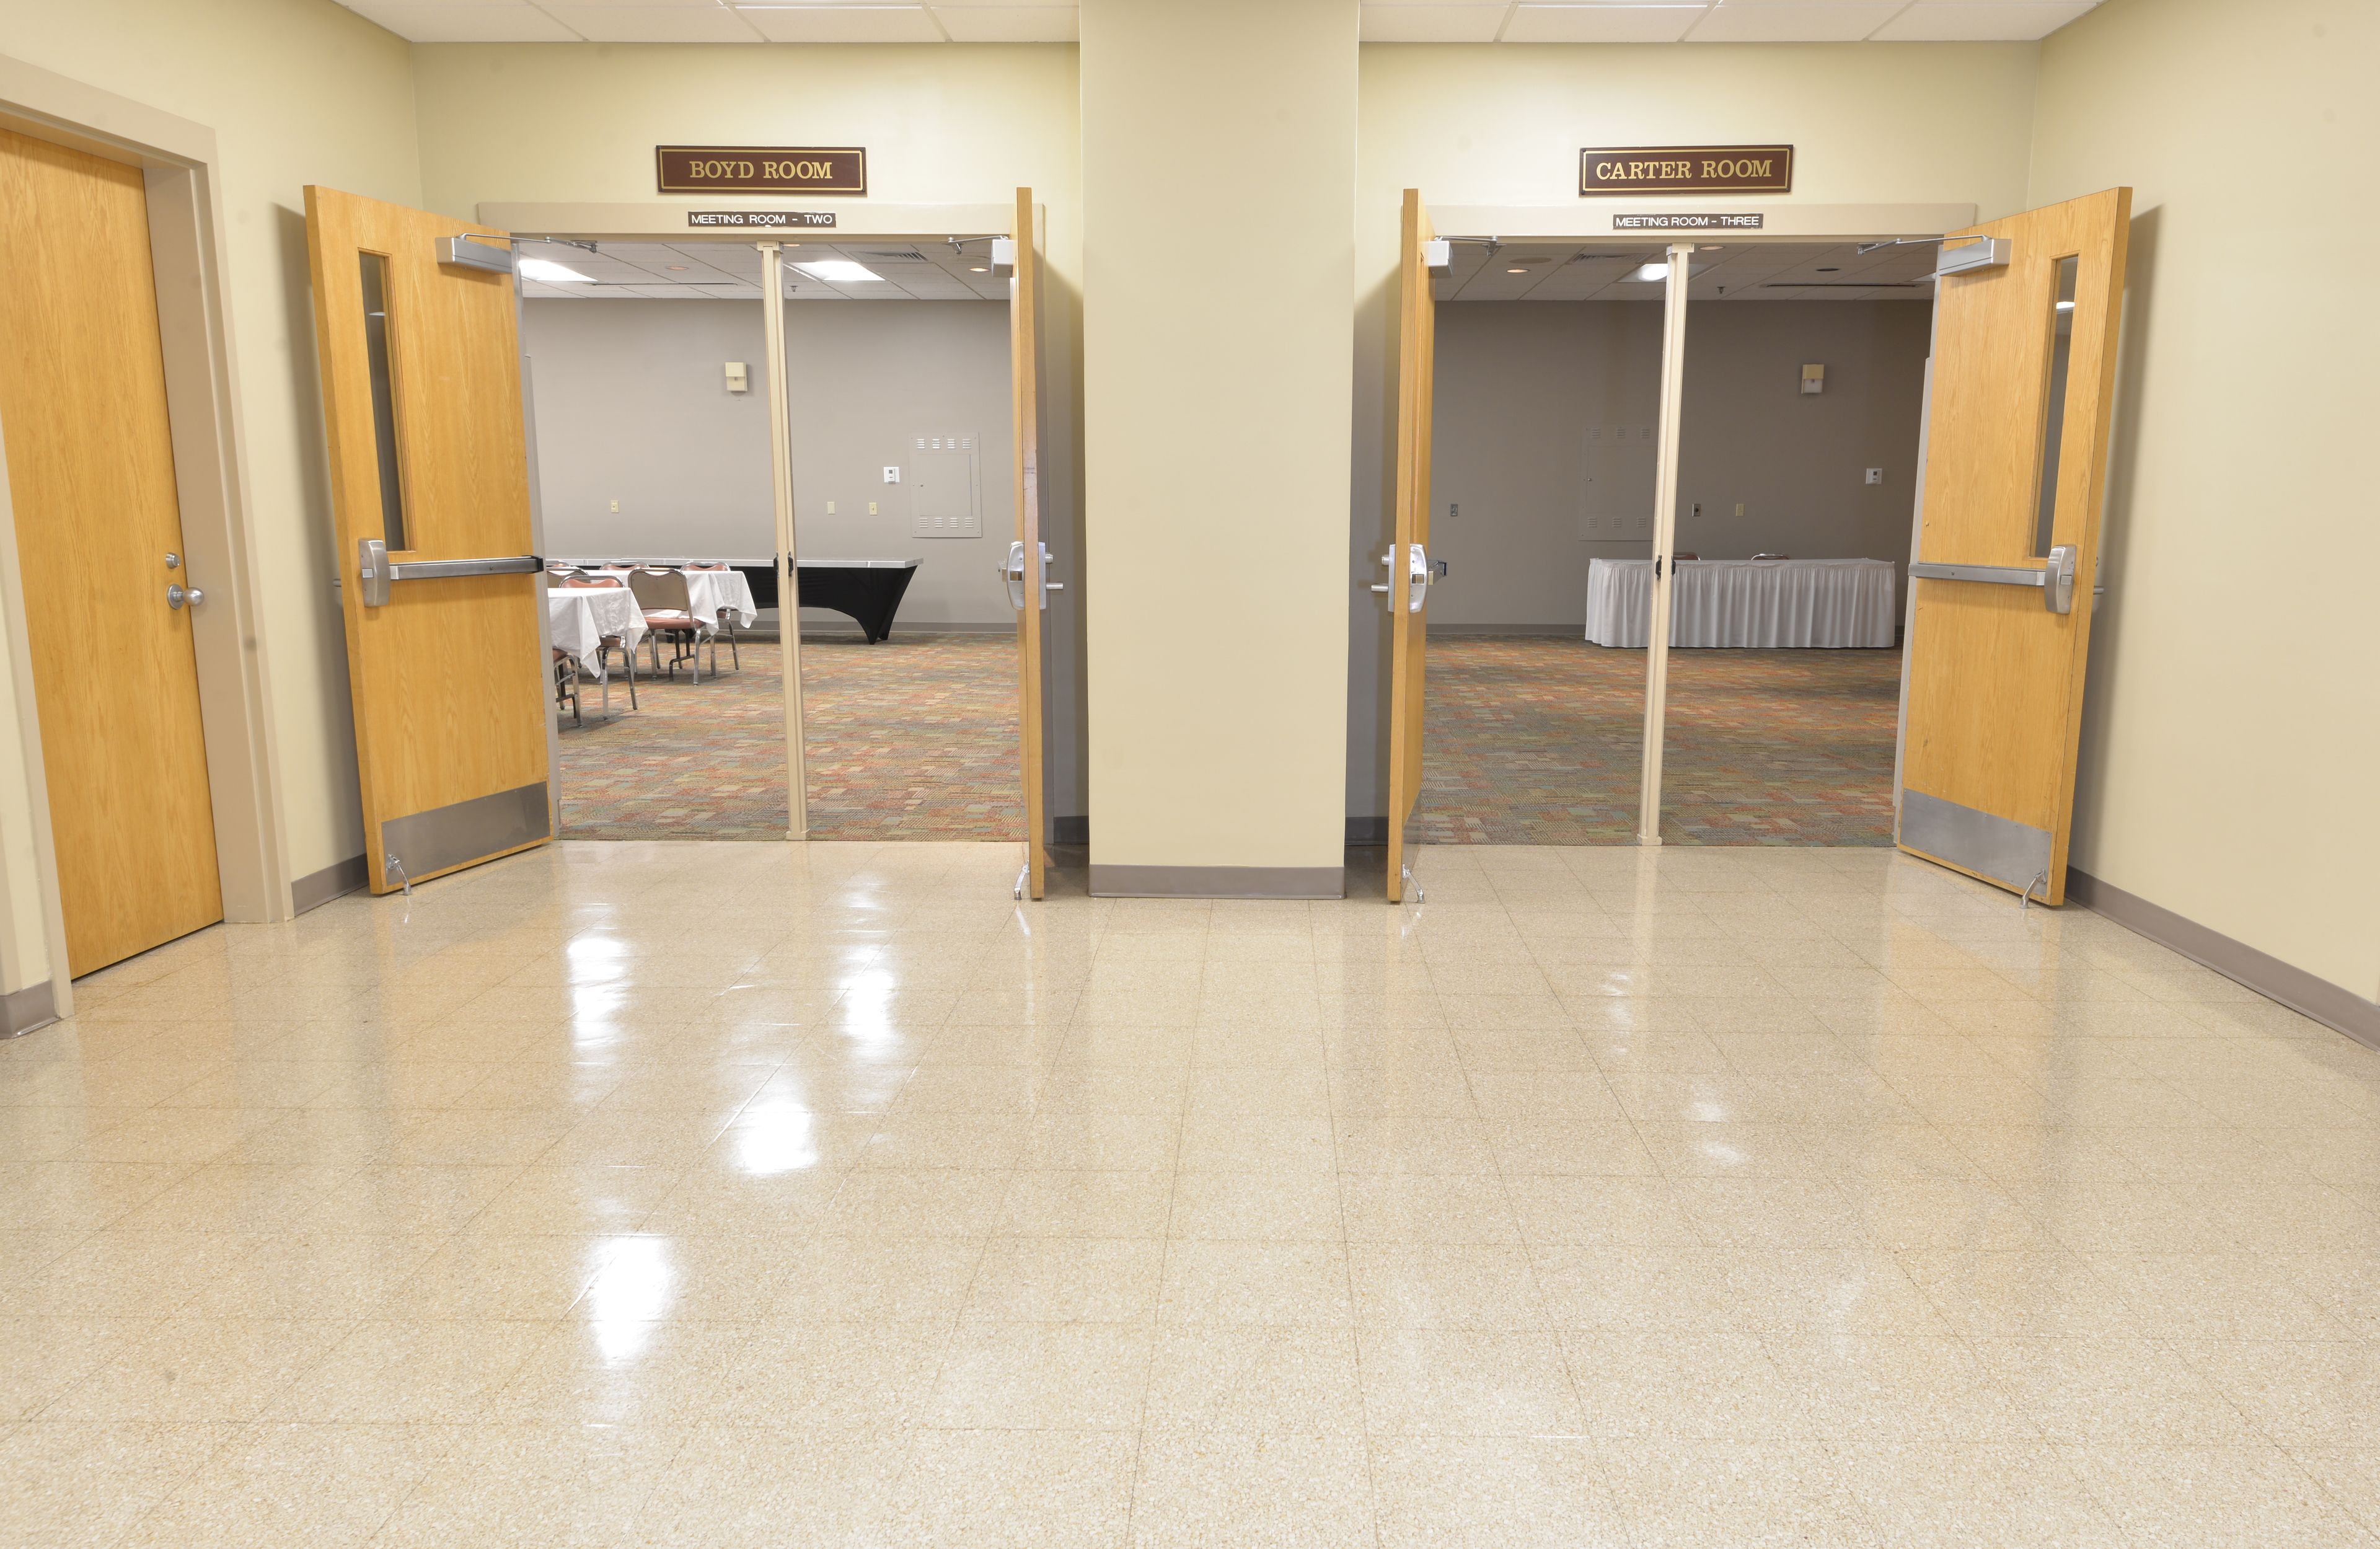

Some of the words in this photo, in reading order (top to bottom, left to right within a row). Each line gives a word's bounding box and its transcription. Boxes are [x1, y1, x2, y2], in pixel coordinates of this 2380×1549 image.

[689, 161, 754, 179] BOYD
[762, 161, 833, 179] ROOM
[1596, 161, 1692, 180] CARTER
[1701, 159, 1773, 178] ROOM
[691, 214, 744, 224] MEETING
[749, 214, 786, 224] ROOM
[803, 214, 833, 224] TWO
[1615, 216, 1668, 227] MEETING
[1671, 216, 1709, 226] ROOM
[1720, 216, 1760, 226] THREE
